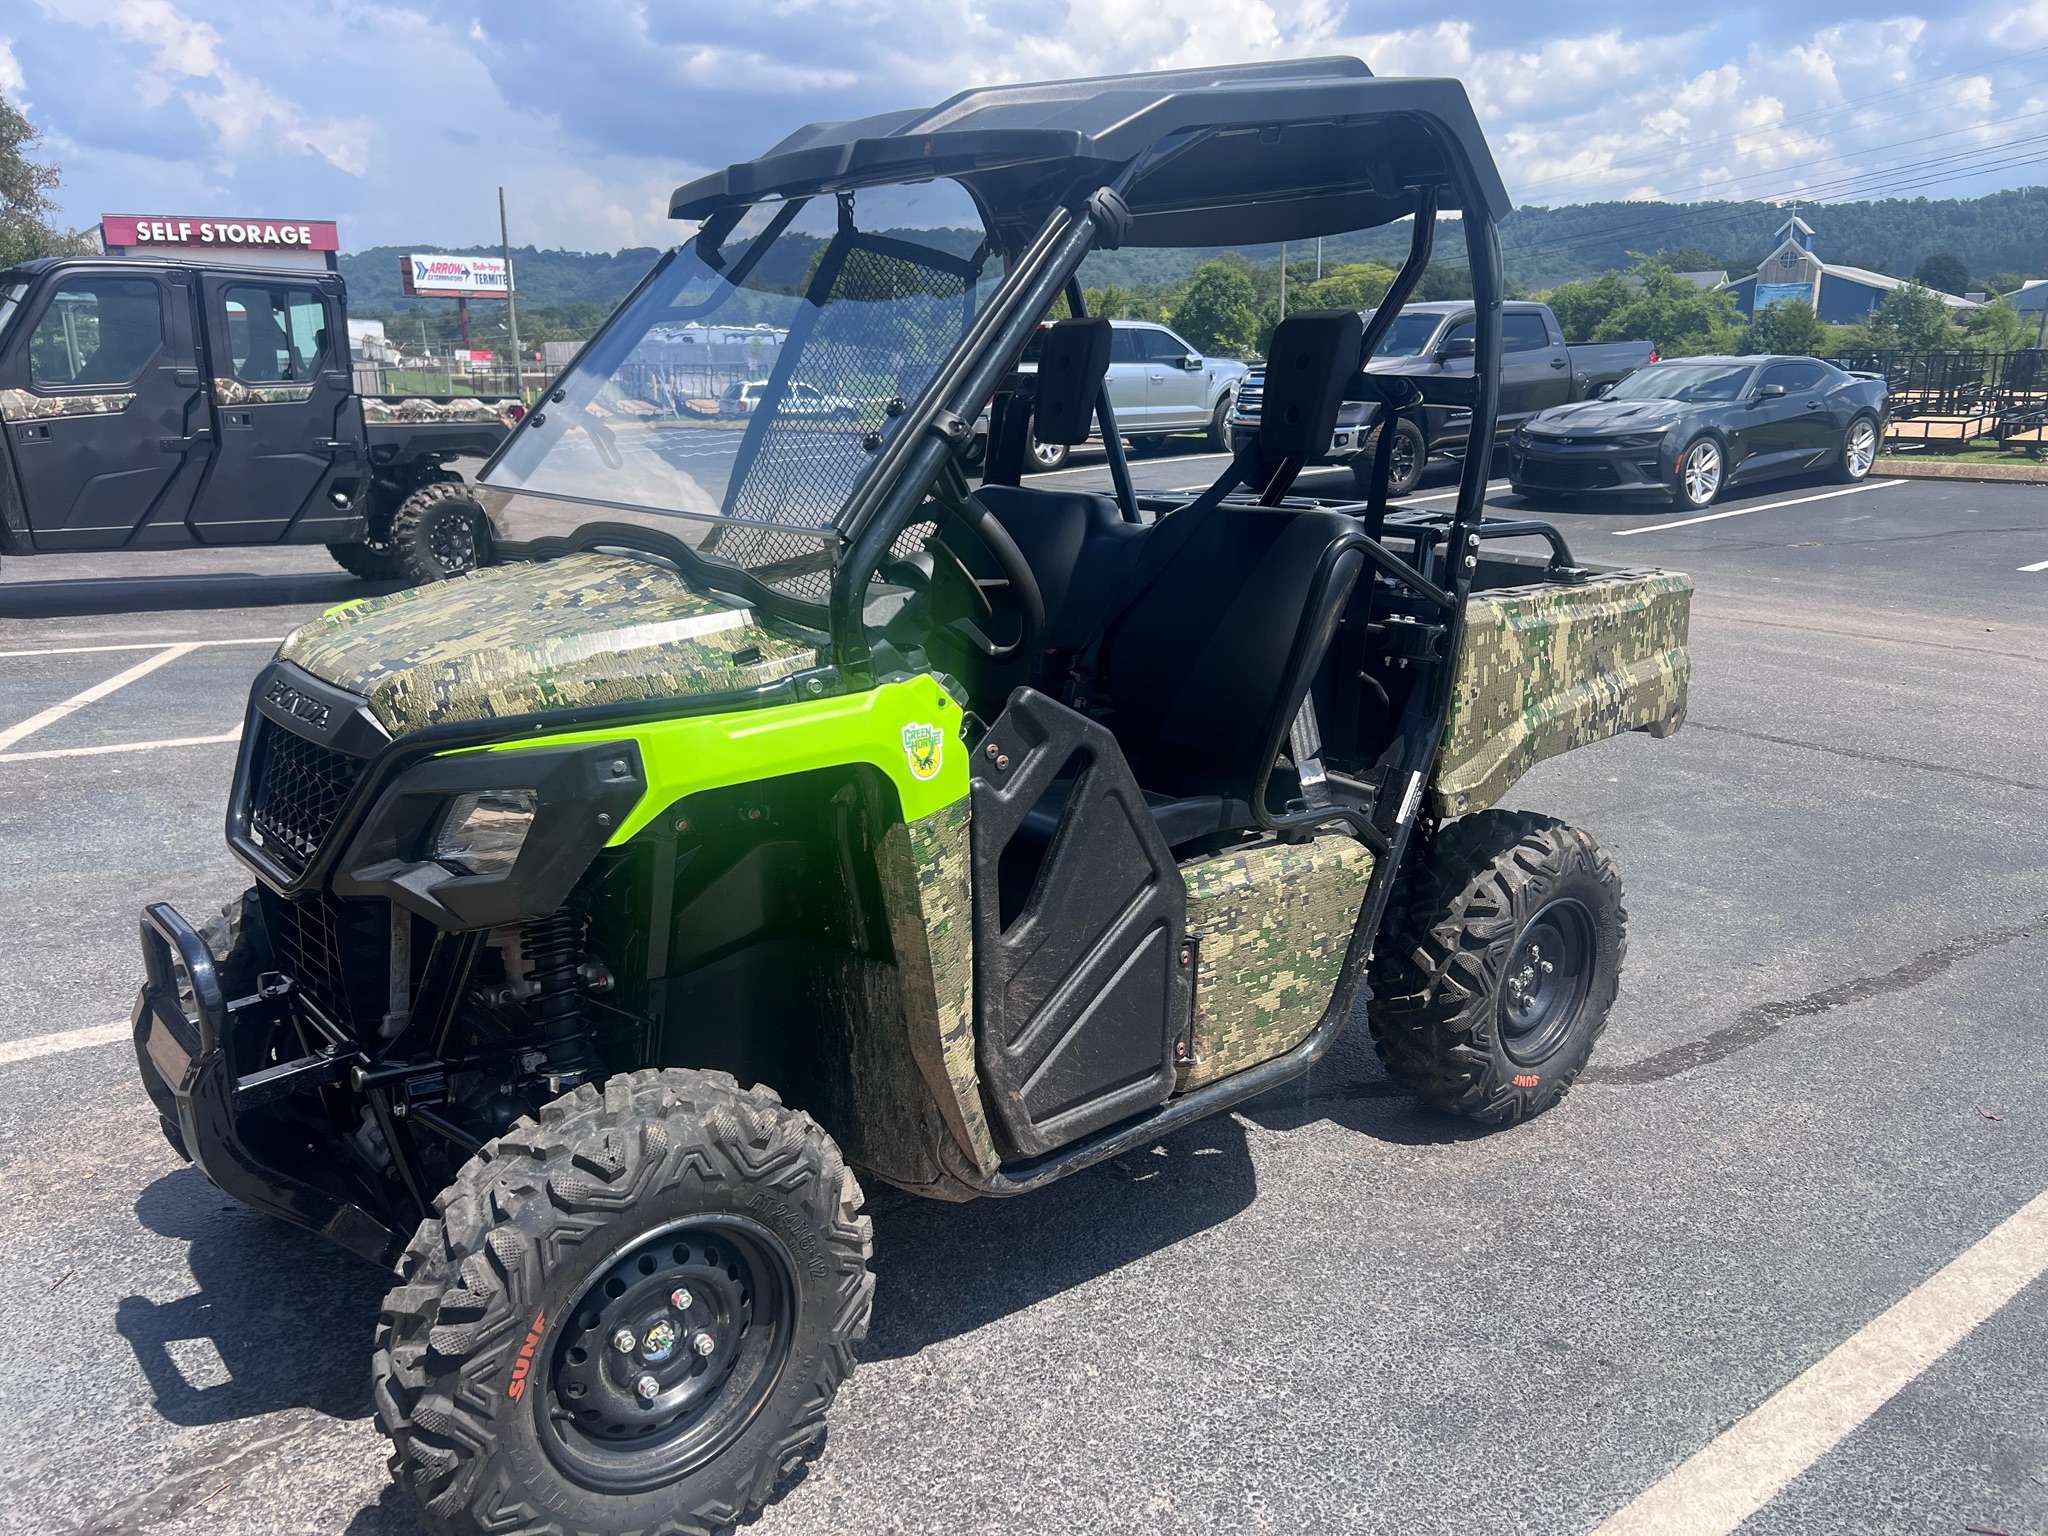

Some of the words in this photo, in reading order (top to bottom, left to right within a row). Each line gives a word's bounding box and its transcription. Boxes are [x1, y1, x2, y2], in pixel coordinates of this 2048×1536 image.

[136, 221, 191, 241] SELF
[200, 223, 312, 245] STORAGE
[429, 262, 463, 274] ARROW
[396, 411, 478, 421] RANGER
[264, 679, 333, 732] HONDA
[904, 726, 931, 746] GREEN
[906, 731, 942, 752] HORNET
[1511, 1074, 1541, 1087] SUNF
[508, 1308, 546, 1404] SUNF
